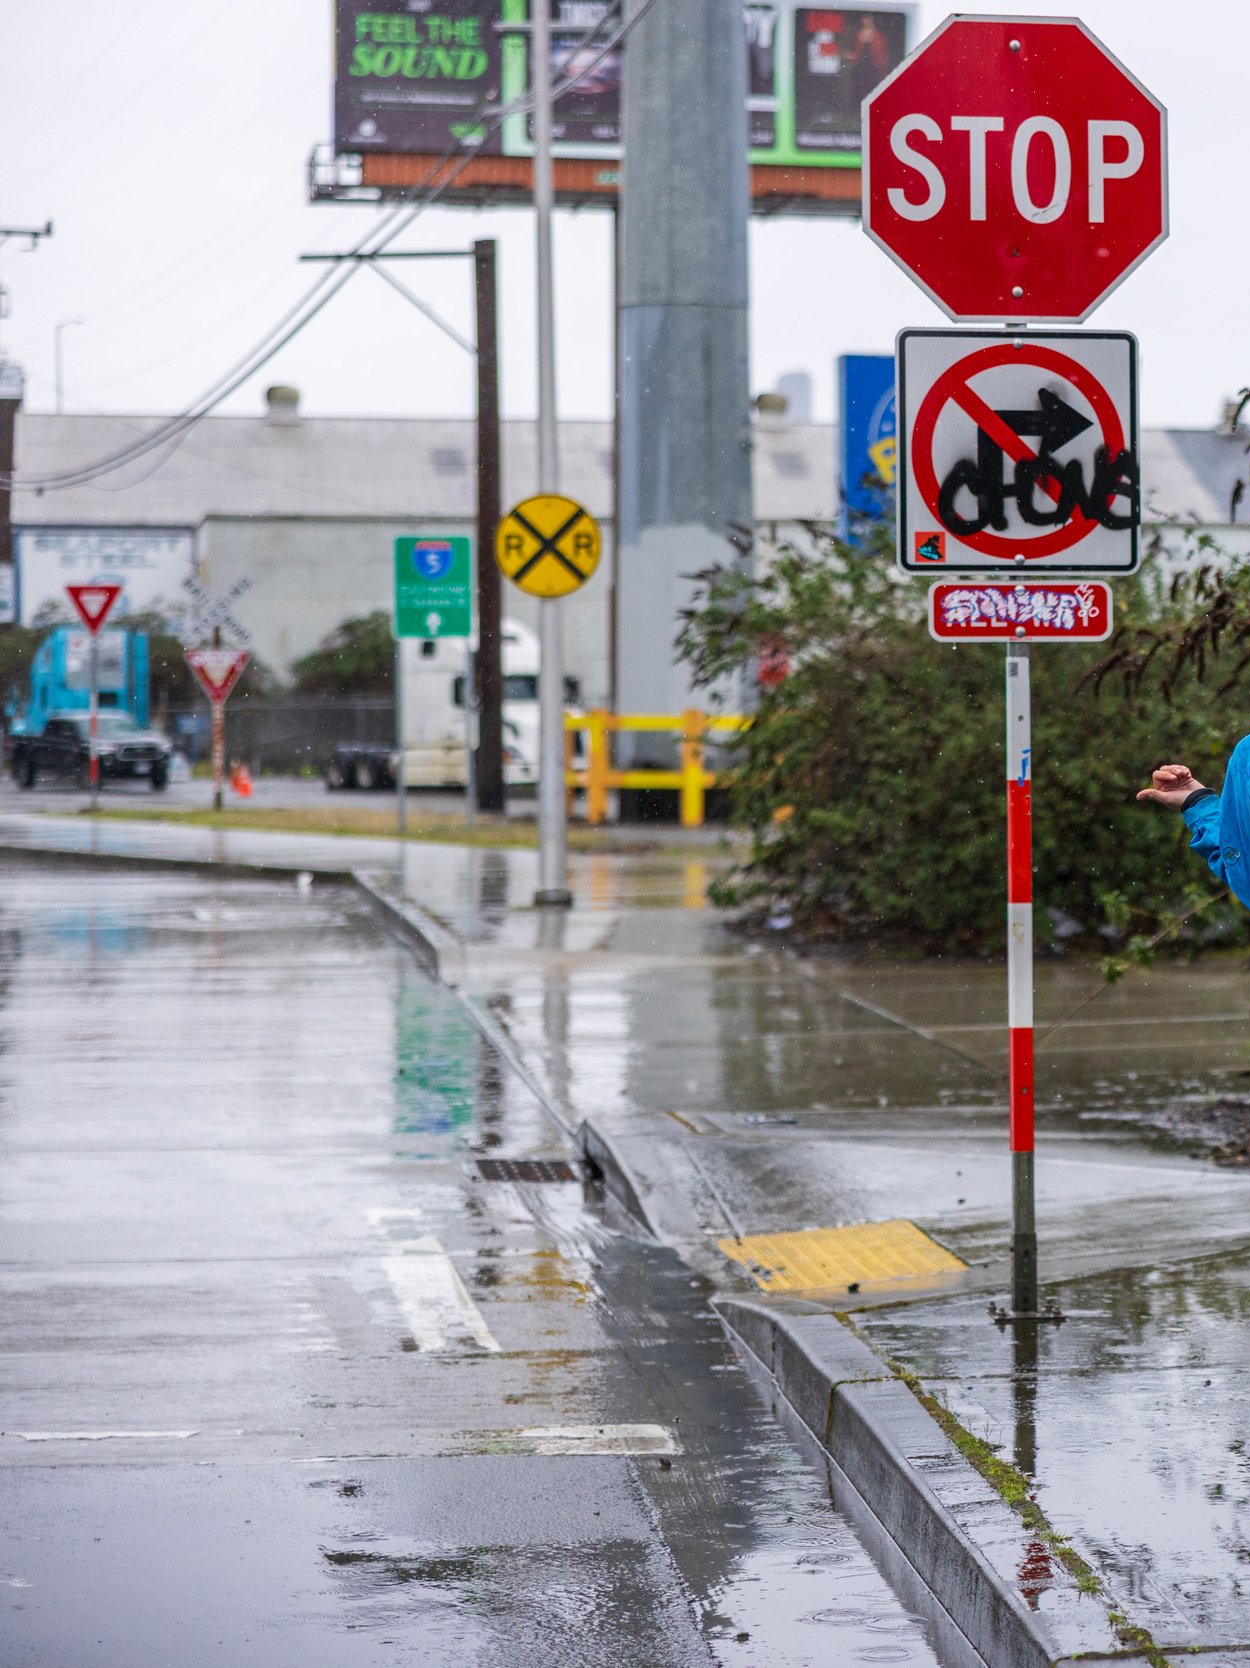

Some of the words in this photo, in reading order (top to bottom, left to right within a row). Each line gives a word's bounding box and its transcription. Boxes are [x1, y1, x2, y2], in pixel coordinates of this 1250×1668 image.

[356, 13, 422, 44] FEEL
[424, 16, 480, 46] THE
[349, 43, 488, 80] SOUND
[887, 113, 1145, 224] STOP
[34, 537, 180, 554] SEAPORT
[503, 532, 525, 559] R
[573, 532, 594, 559] R
[59, 554, 156, 569] STEEL
[425, 553, 442, 574] 5
